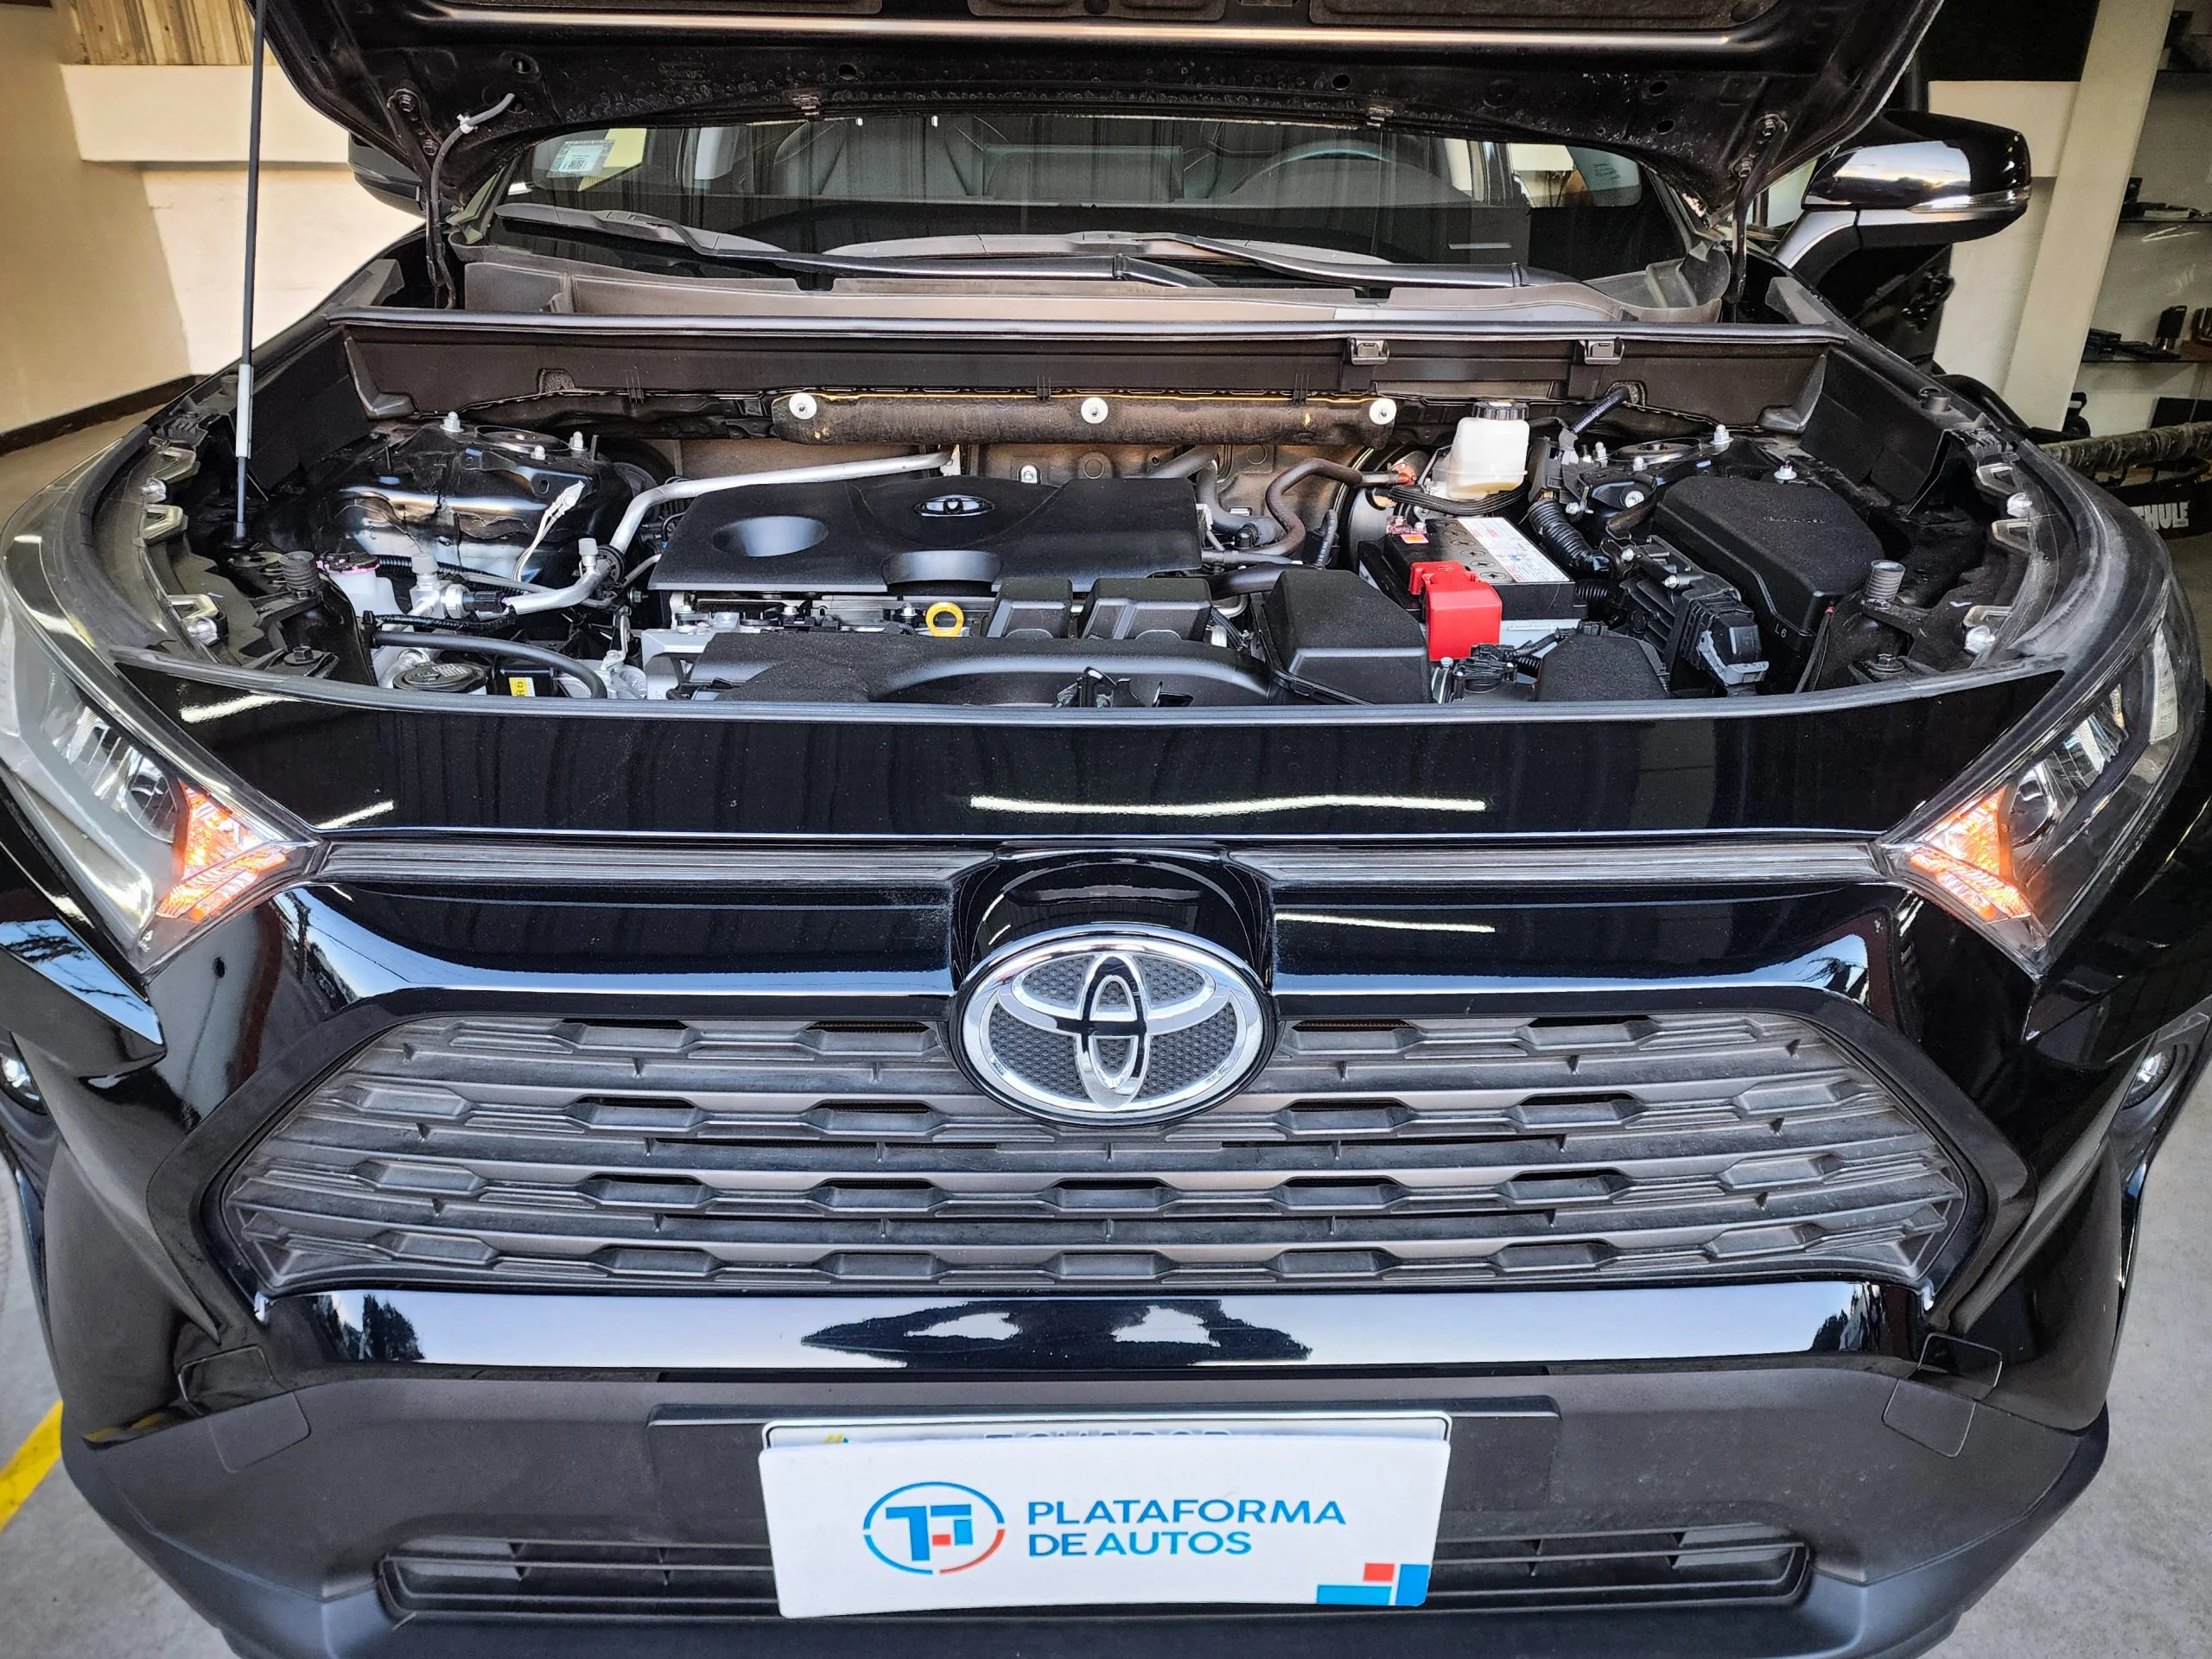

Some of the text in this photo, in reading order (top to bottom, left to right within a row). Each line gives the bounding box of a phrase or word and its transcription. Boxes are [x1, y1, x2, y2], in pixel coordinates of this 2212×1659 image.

[1028, 1500, 1345, 1525] PLATAFORMA
[1029, 1531, 1251, 1557] DE AUTOS
